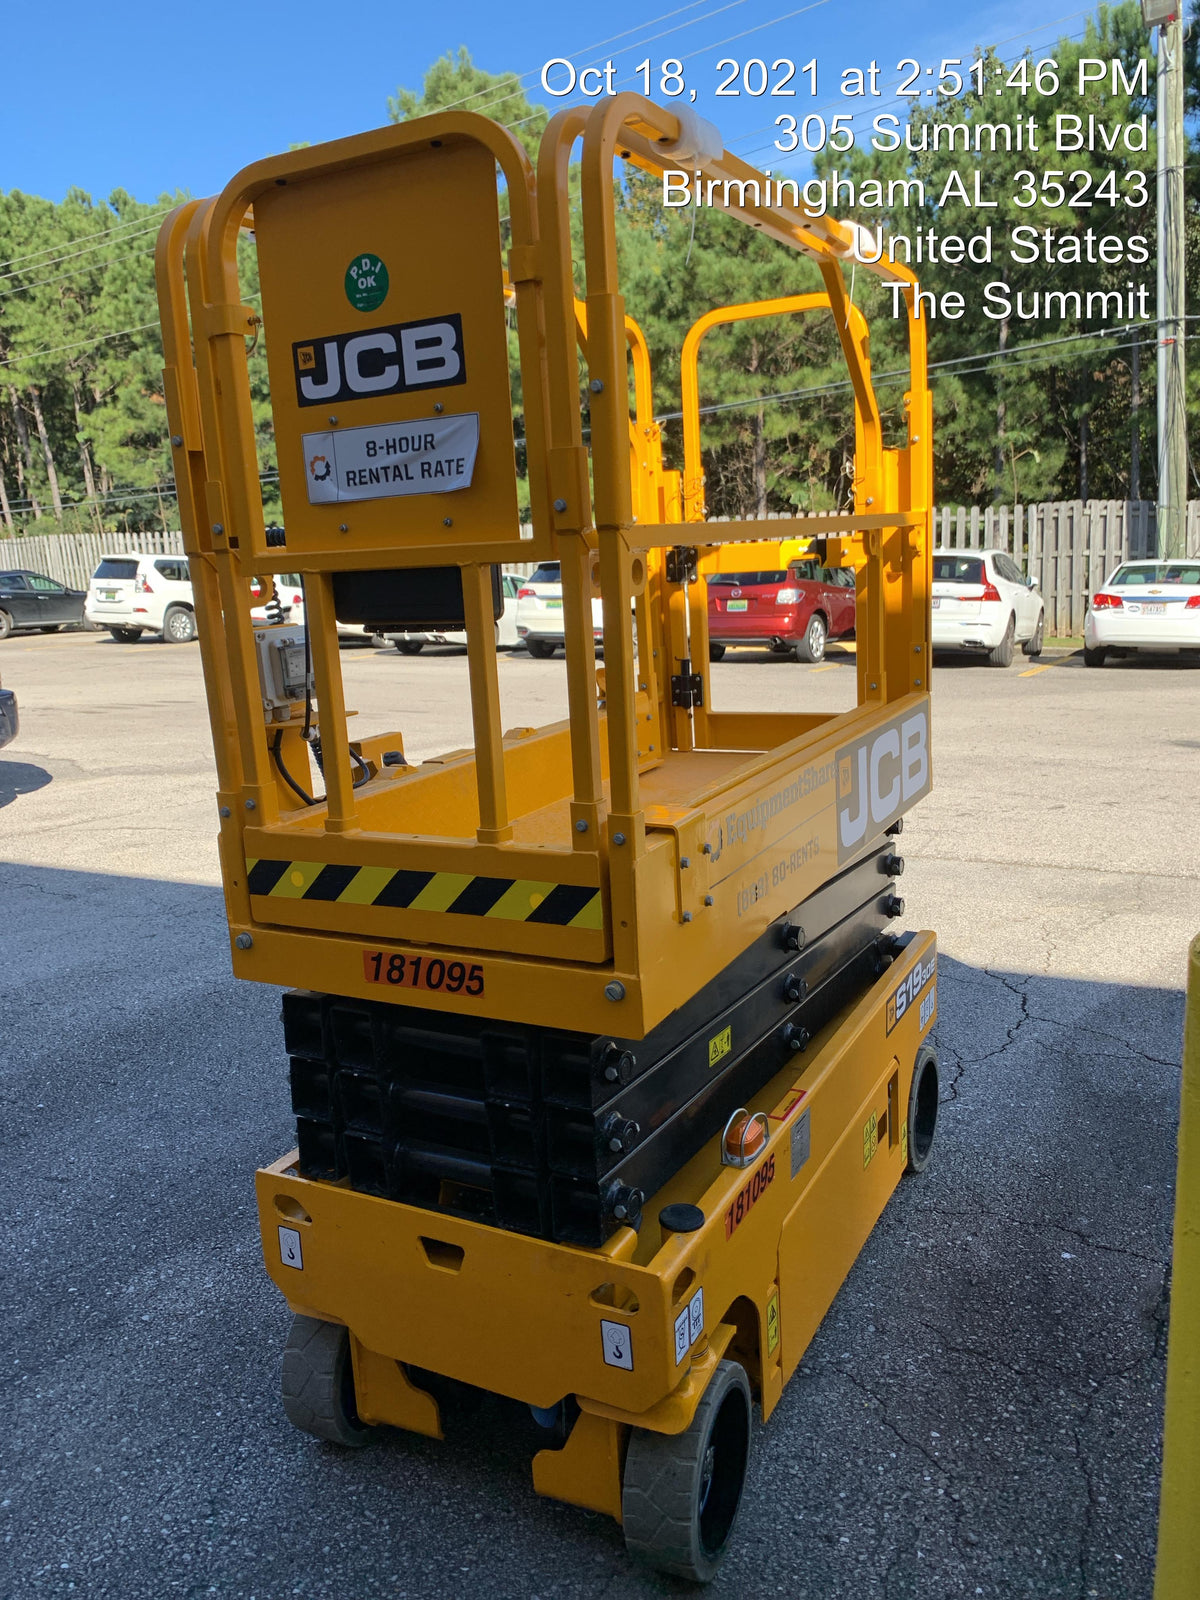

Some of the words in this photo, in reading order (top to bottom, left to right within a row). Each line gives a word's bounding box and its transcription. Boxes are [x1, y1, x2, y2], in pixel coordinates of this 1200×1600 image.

[358, 275, 377, 289] OK
[300, 322, 461, 400] JCB
[346, 464, 414, 487] RENTAL
[421, 457, 466, 480] RATE
[365, 433, 436, 458] 8-HOUR
[726, 759, 840, 846] EquipmentShare
[840, 711, 928, 848] JCB
[370, 951, 484, 996] 181095
[728, 1152, 775, 1235] 181095
